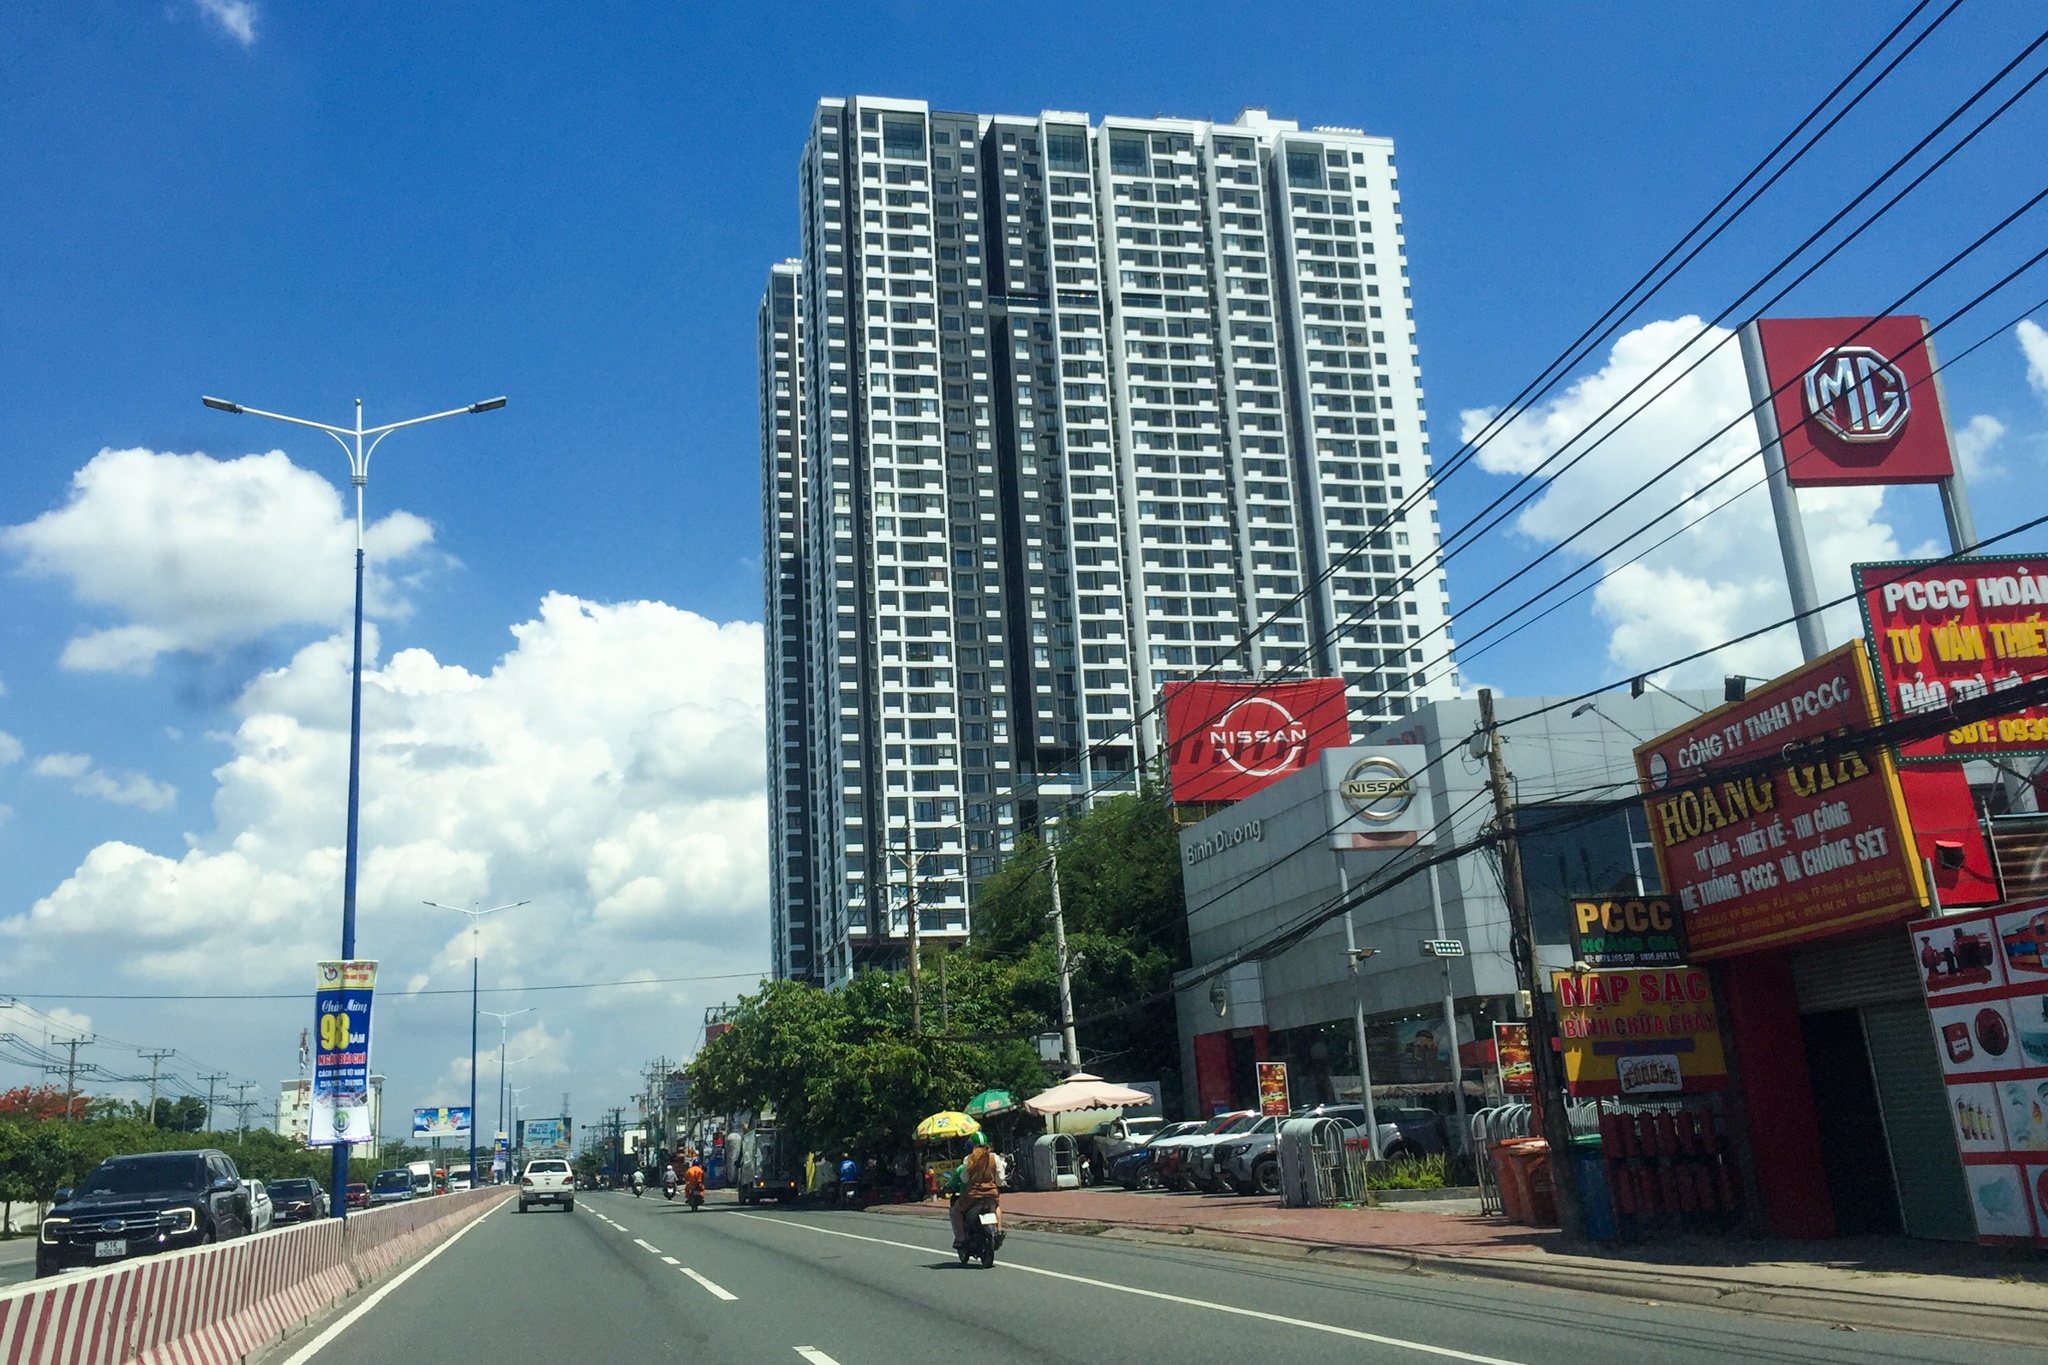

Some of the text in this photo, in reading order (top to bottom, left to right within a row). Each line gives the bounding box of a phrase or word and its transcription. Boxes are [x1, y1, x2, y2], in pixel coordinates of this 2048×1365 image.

[1819, 357, 1900, 431] MG
[1883, 579, 1970, 612] PCCC
[1887, 624, 1923, 663] TƯ
[1931, 615, 1986, 662] VẤN
[1898, 672, 1948, 714] BẢO
[1210, 729, 1307, 744] NISSAN
[1678, 677, 1851, 768] CÔNG TY TNHH PCCC
[1787, 730, 1870, 798] GIA
[1348, 782, 1410, 794] NISSAN
[1215, 820, 1261, 852] Dương
[1693, 846, 1710, 871] TƯ
[1736, 822, 1769, 857] THIẾT
[1767, 813, 1788, 849] KẾ
[1791, 814, 1815, 840] THI
[1813, 802, 1852, 833] CÔNG
[1680, 824, 1888, 914] HỆ THỐNG PCCC VÀ CHỐNG SÉT
[1575, 900, 1673, 934] PCCC
[1559, 972, 1708, 1012] NẠP SẠC
[321, 1012, 350, 1050] 98
[1563, 1011, 1610, 1039] BÌNH
[1614, 1009, 1665, 1036] CHỮA
